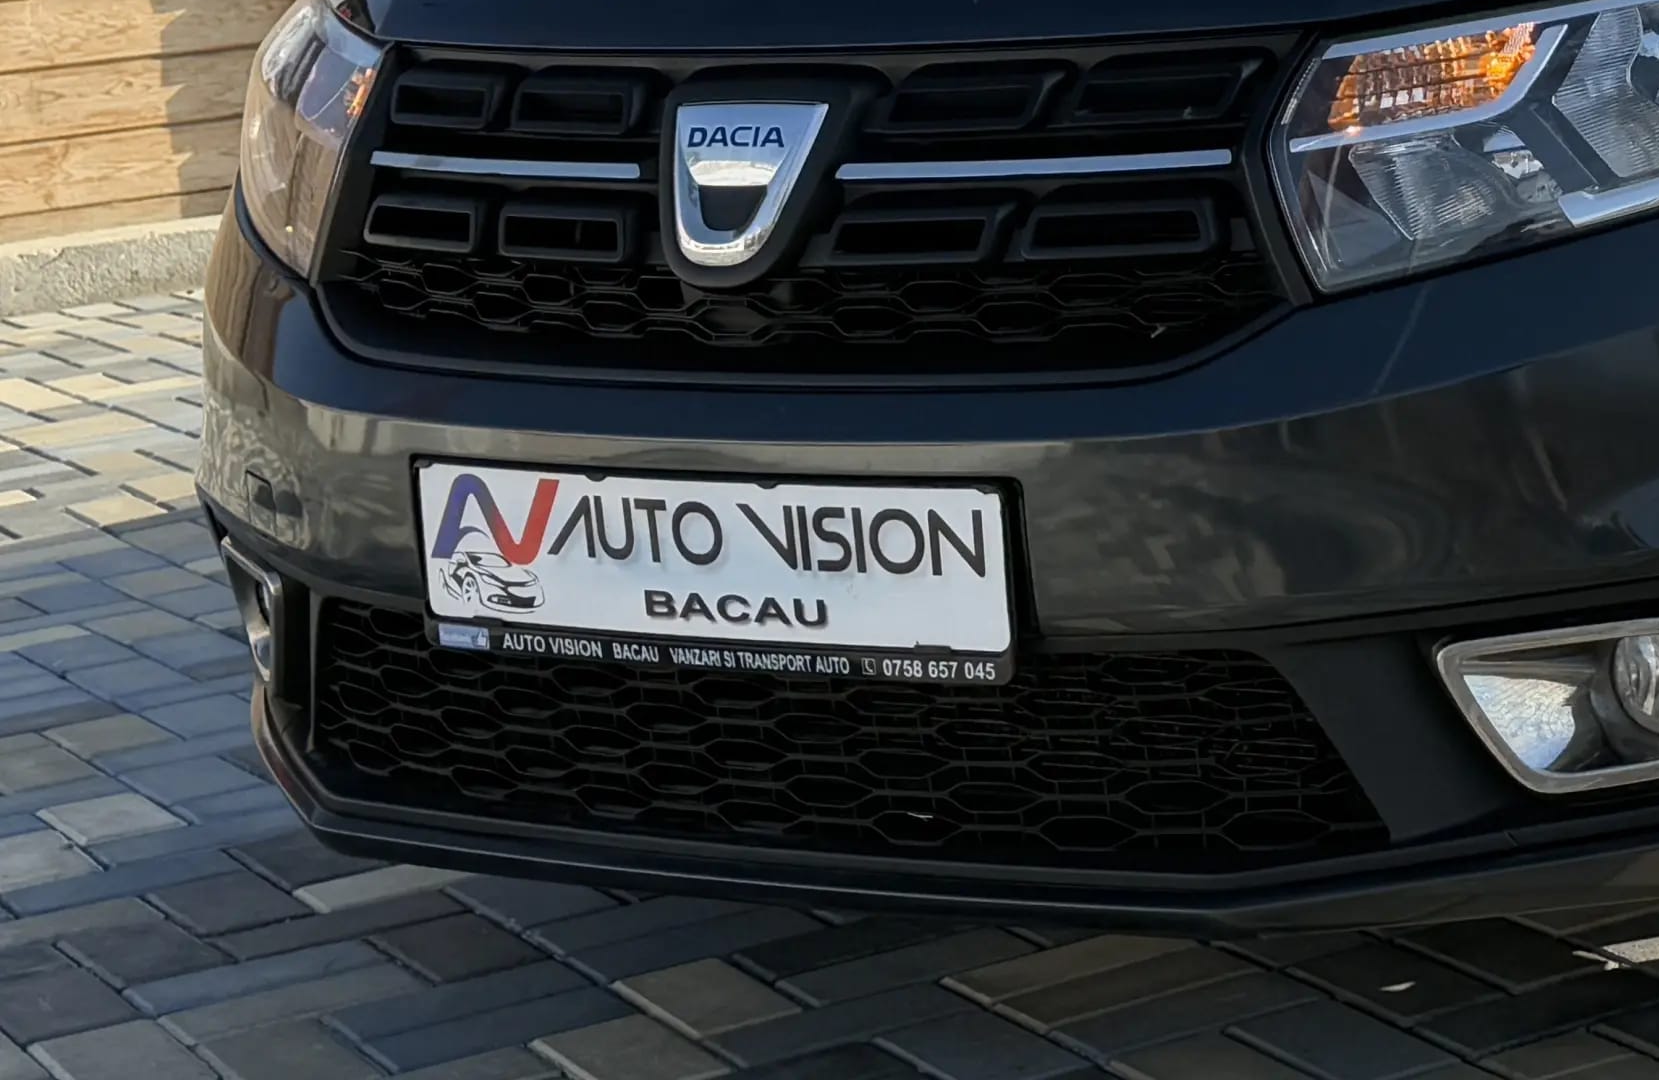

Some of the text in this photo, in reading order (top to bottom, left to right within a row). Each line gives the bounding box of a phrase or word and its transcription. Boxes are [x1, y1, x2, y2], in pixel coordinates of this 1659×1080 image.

[687, 126, 785, 149] DACIA
[548, 494, 988, 579] AUTO VISION
[643, 589, 832, 629] BACAU
[503, 632, 997, 681] AUTO VISION BACAU VANZARI SI TRANSPORT AUTO 0758 657 045
